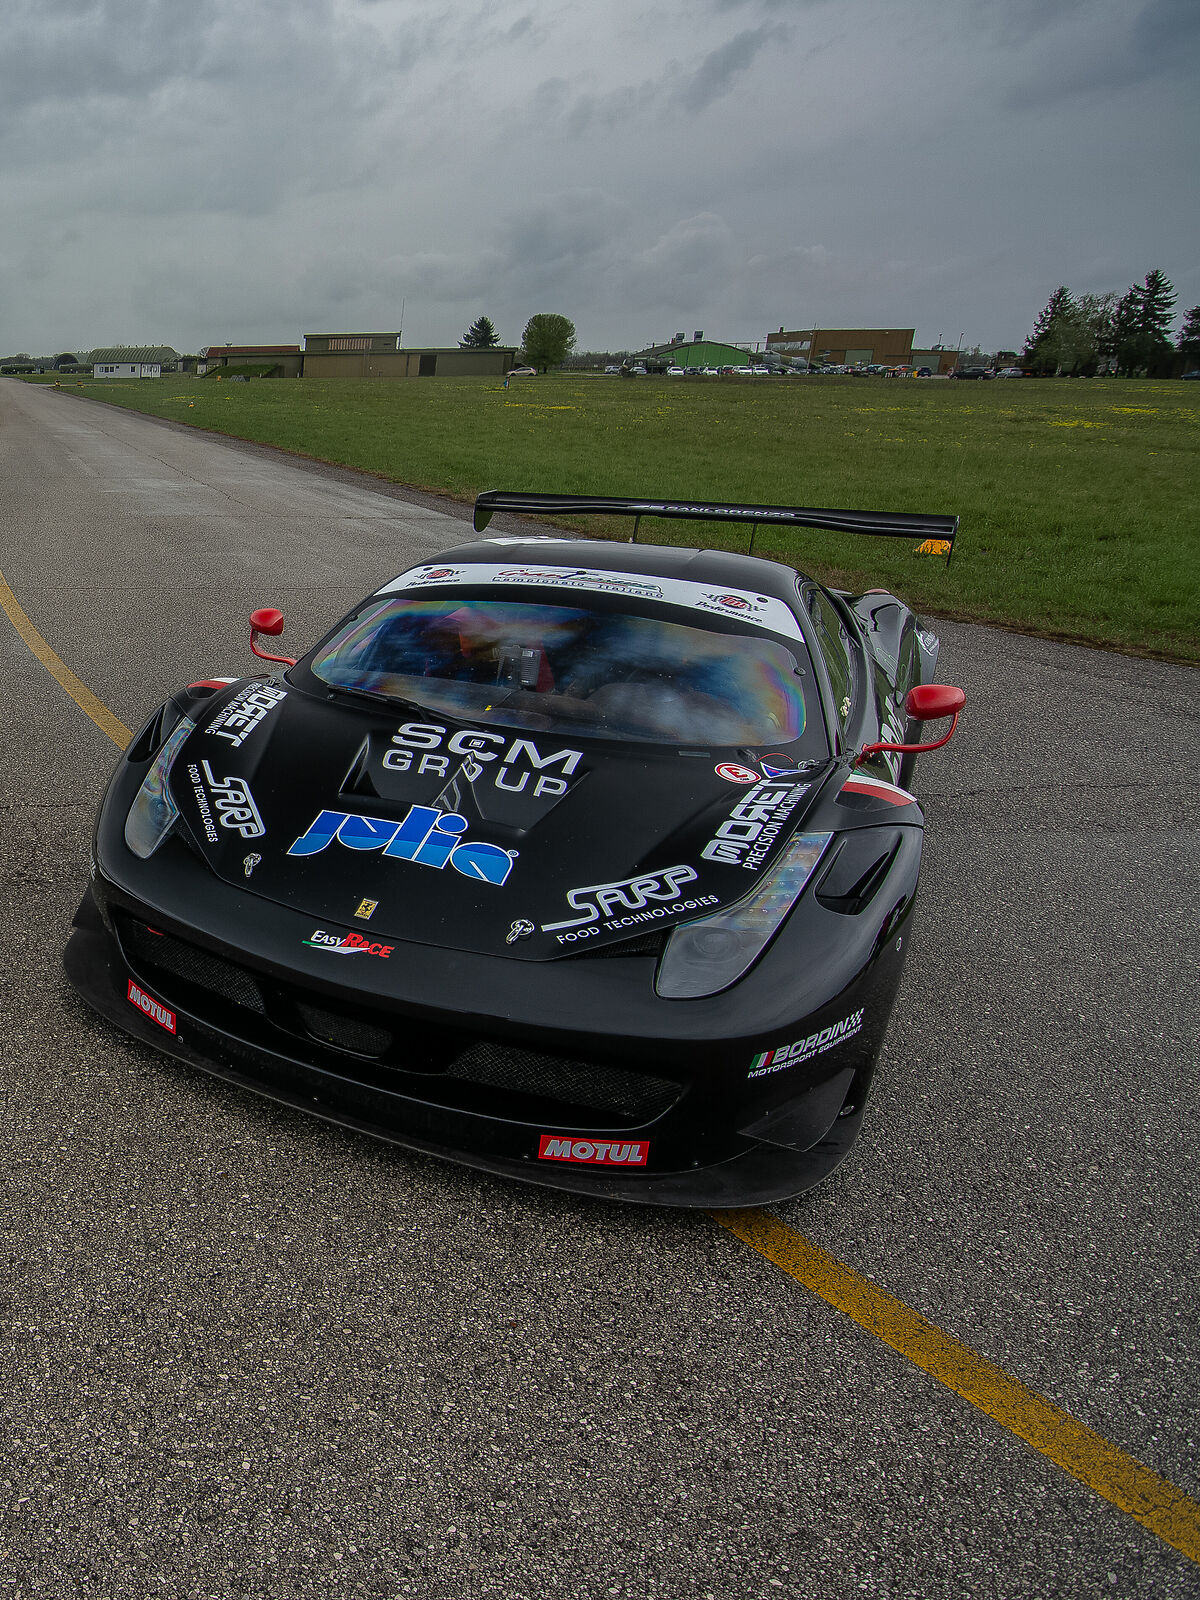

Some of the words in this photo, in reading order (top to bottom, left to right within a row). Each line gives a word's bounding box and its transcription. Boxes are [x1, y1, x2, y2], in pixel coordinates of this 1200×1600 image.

[695, 601, 763, 623] Performance
[216, 685, 288, 747] MORET
[187, 764, 202, 784] FOOD
[382, 749, 570, 798] GROUP
[392, 722, 584, 776] SCM
[193, 785, 219, 843] TECHNOLOGIES
[201, 759, 267, 839] SARP
[700, 779, 796, 865] MORET
[286, 804, 516, 887] julia
[742, 821, 784, 871] PRECISION
[772, 783, 812, 821] MACHINING
[540, 864, 699, 932] SARP
[556, 926, 601, 944] FOOD
[603, 894, 720, 931] TECHNOLOGIES
[130, 985, 174, 1030] MOTUL
[747, 1048, 818, 1079] MOTORSPORT
[818, 1023, 863, 1054] EQUIPMENT
[772, 1016, 851, 1065] BORDIN
[543, 1139, 644, 1162] MOTUL
